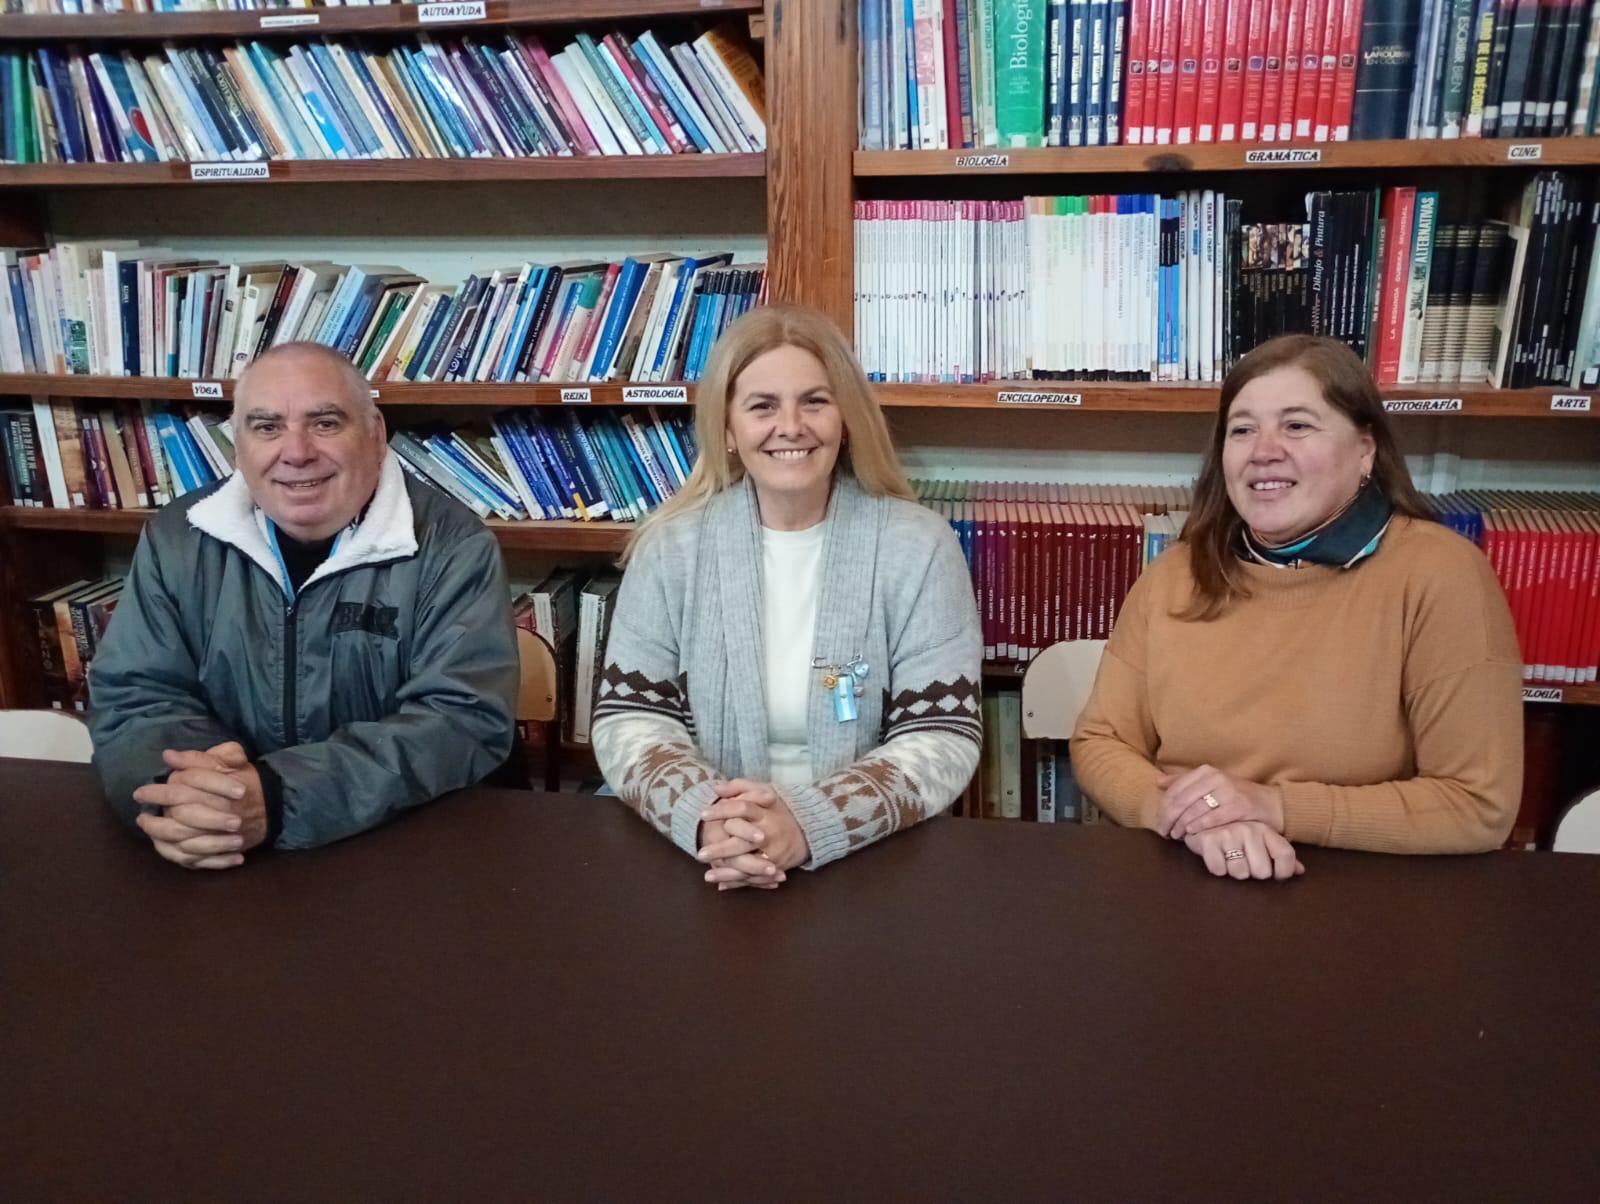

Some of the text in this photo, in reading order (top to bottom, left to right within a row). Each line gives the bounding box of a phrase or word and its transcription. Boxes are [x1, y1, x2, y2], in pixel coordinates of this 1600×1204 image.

[421, 5, 482, 17] AUTOAYUDA
[1480, 12, 1494, 39] LIBRO
[1454, 16, 1470, 63] ESCRIBIR
[1477, 43, 1490, 54] DE
[1475, 57, 1489, 74] LOS
[1451, 66, 1463, 93] BIEN
[1248, 150, 1318, 162] GRAMÁTICA
[1510, 147, 1538, 157] CINE
[194, 167, 266, 177] ESPIRITUALIDAD
[1416, 197, 1435, 263] ALTERNATIVAS
[1312, 210, 1325, 291] Dibujo & Pintura
[1390, 206, 1408, 340] LA SEGUNDA GUERRA MUNDIAL
[194, 385, 218, 396] YOGA
[563, 391, 588, 400] REIKI
[625, 387, 684, 399] ASTROLOGÍA
[999, 393, 1078, 403] ENCICLOPEDIAS
[1554, 398, 1588, 408] ARTE
[1385, 400, 1459, 411] FOTOGRAFÍA
[24, 419, 37, 470] MANFREDI
